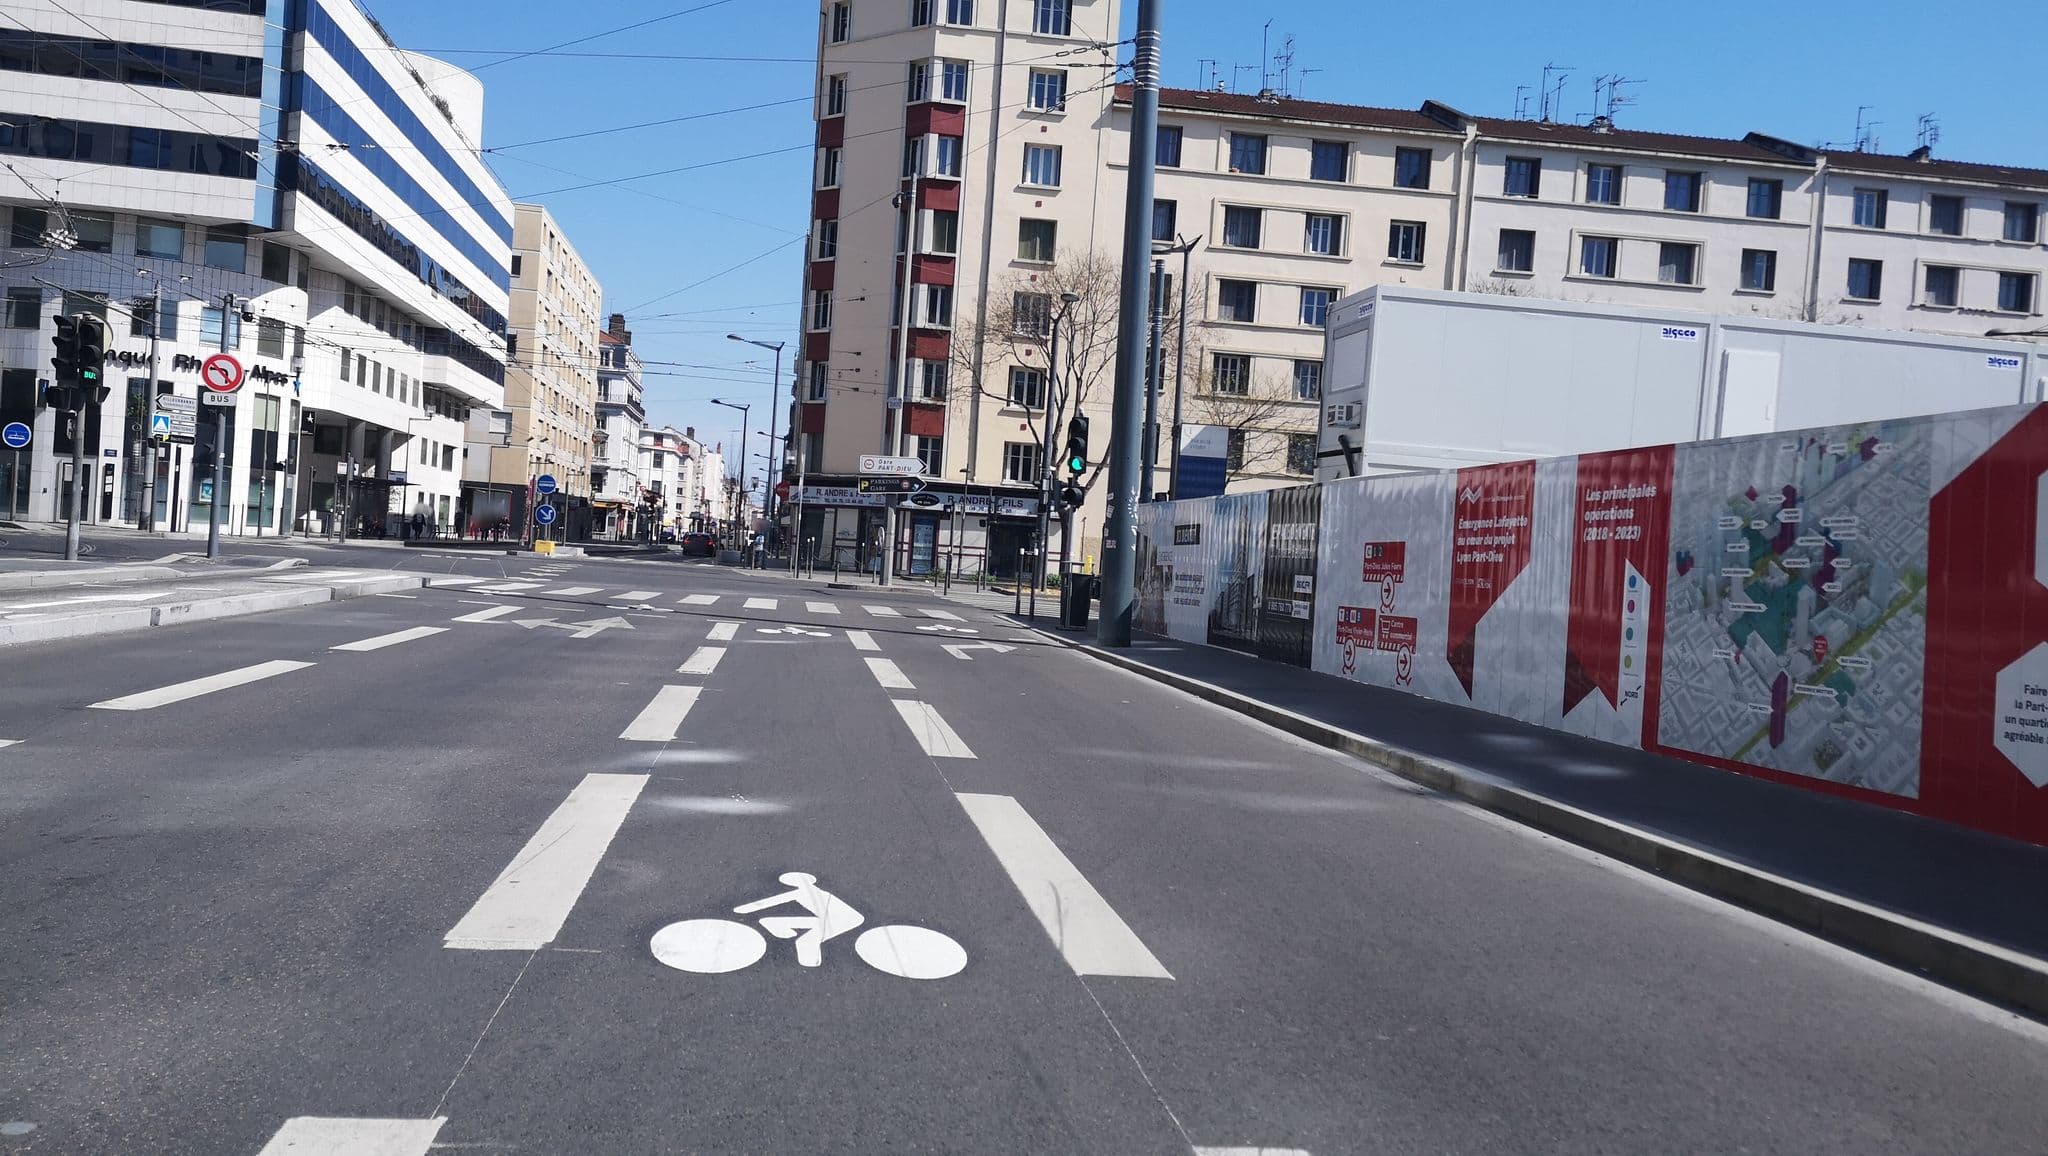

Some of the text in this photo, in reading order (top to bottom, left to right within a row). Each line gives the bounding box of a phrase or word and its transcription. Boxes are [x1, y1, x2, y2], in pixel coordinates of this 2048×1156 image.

[210, 395, 230, 403] BUS
[861, 481, 869, 490] P
[1586, 483, 1657, 503] Les principales
[1002, 498, 1024, 508] FILS
[1584, 506, 1634, 524] opérations
[1494, 514, 1528, 530] Lafayette
[1457, 536, 1466, 546] au
[1484, 533, 1492, 546] du
[1493, 532, 1516, 548] projet
[1584, 527, 1608, 542] (2018
[1615, 525, 1641, 542] 2023)
[1457, 550, 1504, 565] Lyon Part-Dieu
[1624, 690, 1639, 699] NORD
[2024, 684, 2048, 697] Faire
[2015, 700, 2023, 710] la
[2004, 716, 2017, 724] un
[2004, 731, 2044, 744] agréable
